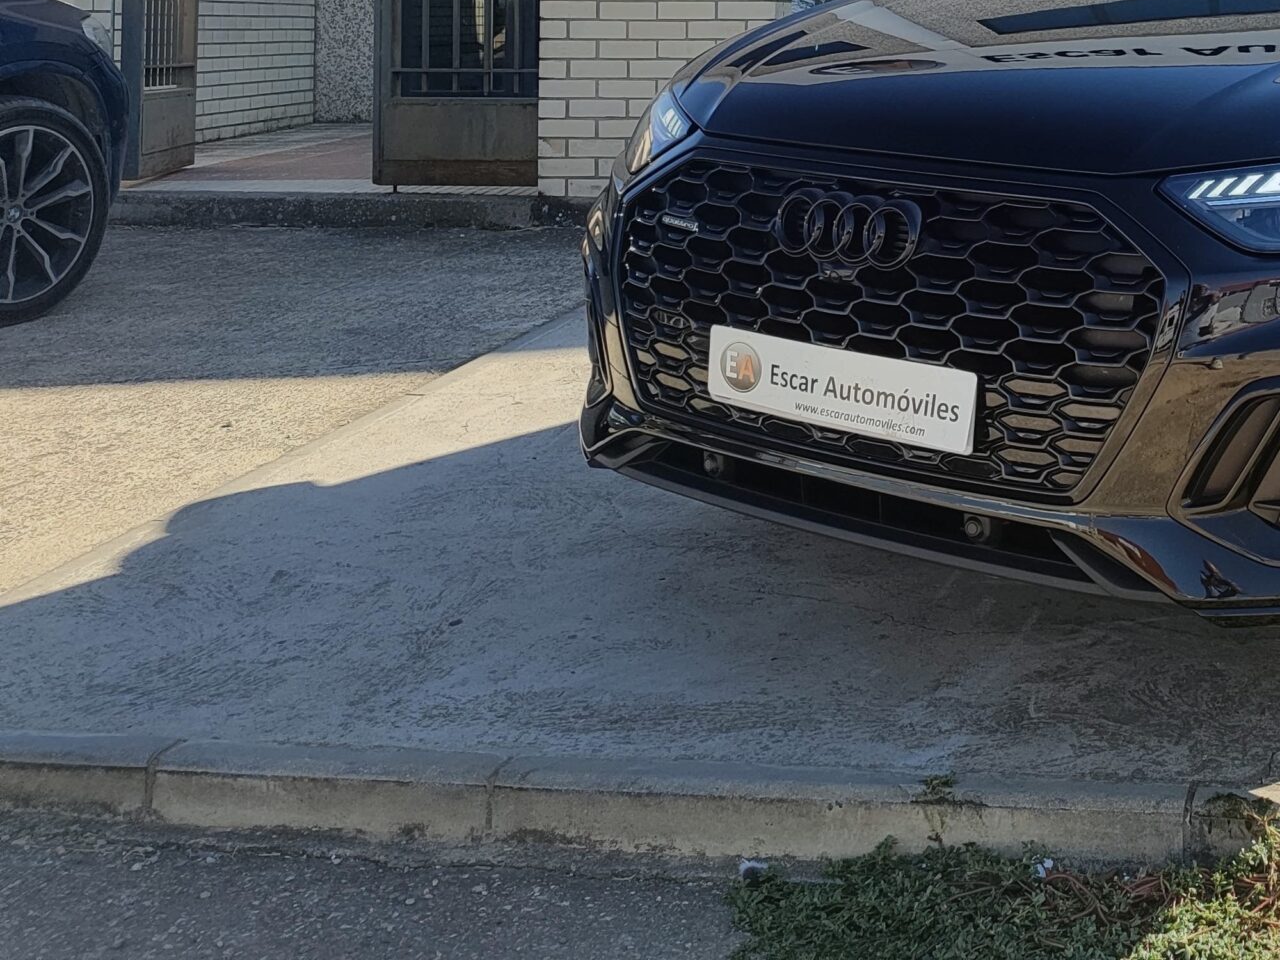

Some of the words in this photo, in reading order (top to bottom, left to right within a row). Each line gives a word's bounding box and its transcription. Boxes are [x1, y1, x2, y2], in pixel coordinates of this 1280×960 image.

[724, 350, 756, 383] EA
[770, 363, 819, 394] Escar
[823, 375, 960, 423] Automóviles
[794, 400, 926, 437] www.escarautomoviles.com
